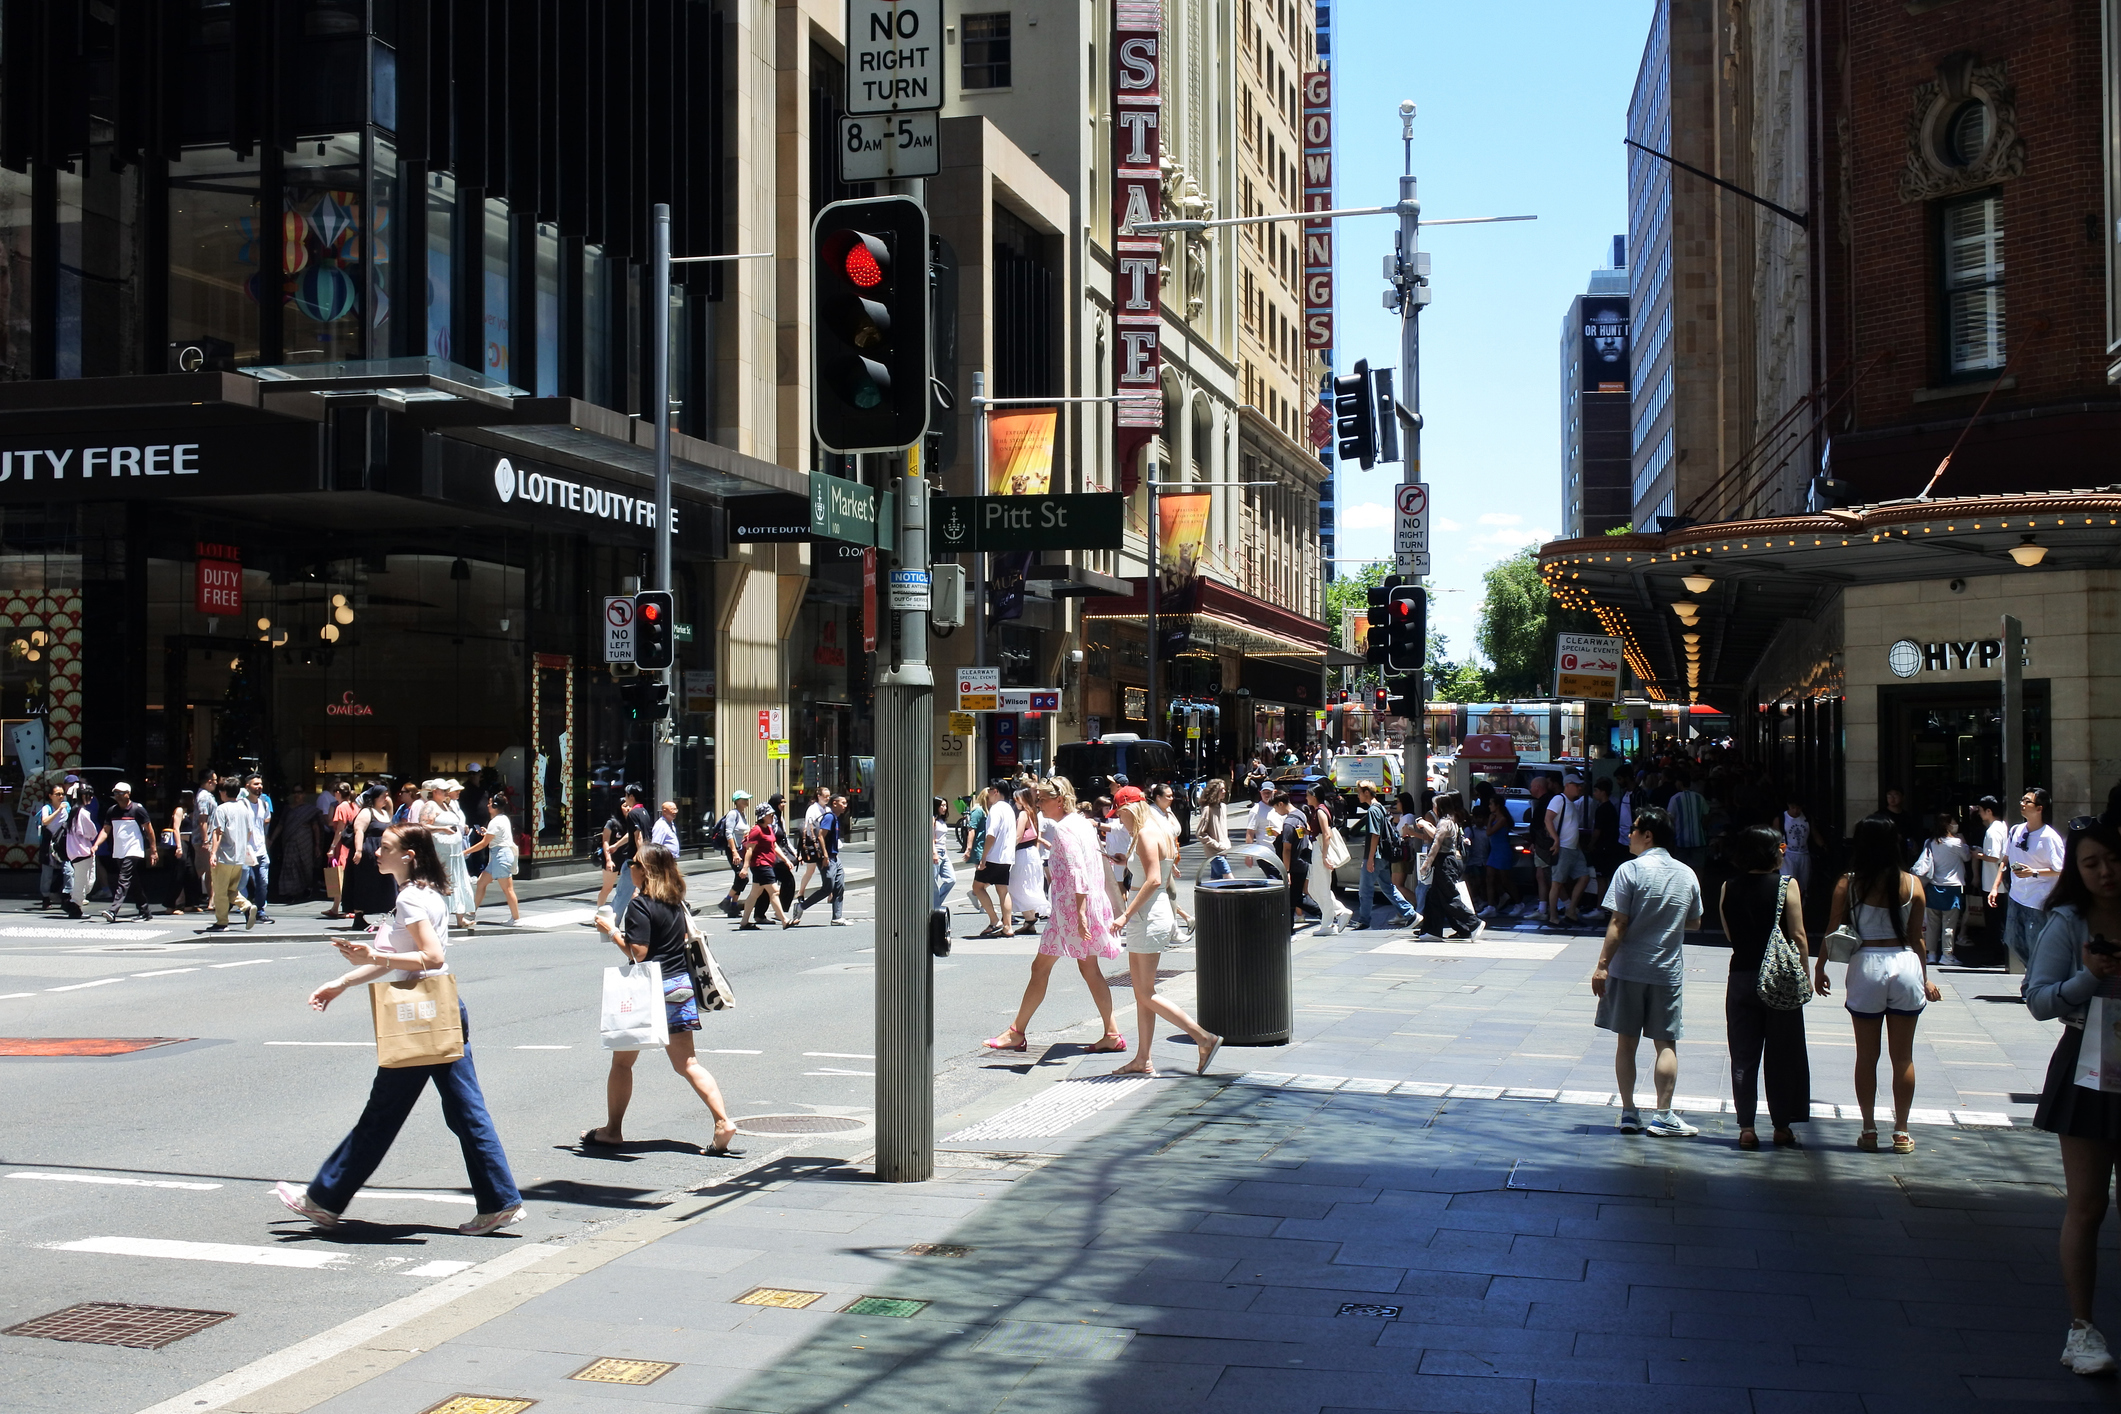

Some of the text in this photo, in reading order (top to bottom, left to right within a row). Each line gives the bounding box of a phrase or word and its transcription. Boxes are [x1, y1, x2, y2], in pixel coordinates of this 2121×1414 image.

[870, 9, 919, 42] NO
[860, 47, 930, 72] RIGHT
[862, 77, 928, 101] TURN
[1118, 38, 1160, 383] STATE
[1306, 75, 1330, 345] GOWINGS
[1584, 325, 1597, 337] OR
[1599, 325, 1623, 337] HUNT
[82, 443, 199, 478] FREE
[518, 470, 679, 534] LOTTE DUTY FRE
[831, 485, 868, 521] Market
[985, 501, 1068, 529] Pitt St
[747, 526, 807, 534] LOTTE DUTY
[1403, 518, 1421, 529] NO
[1399, 531, 1424, 539] RIGHT
[1400, 541, 1423, 549] TURN
[204, 568, 239, 587] DUTY
[203, 588, 238, 607] FREE
[611, 629, 629, 640] NO
[610, 641, 631, 649] LEFT
[1566, 637, 1616, 647] CLEARWAY
[1561, 645, 1620, 655] SPECIAL EVENTS
[326, 703, 373, 716] OMEGA
[1000, 722, 1010, 733] P
[941, 734, 963, 751] 55
[420, 1002, 434, 1010] UNI
[420, 1010, 435, 1018] QLO
